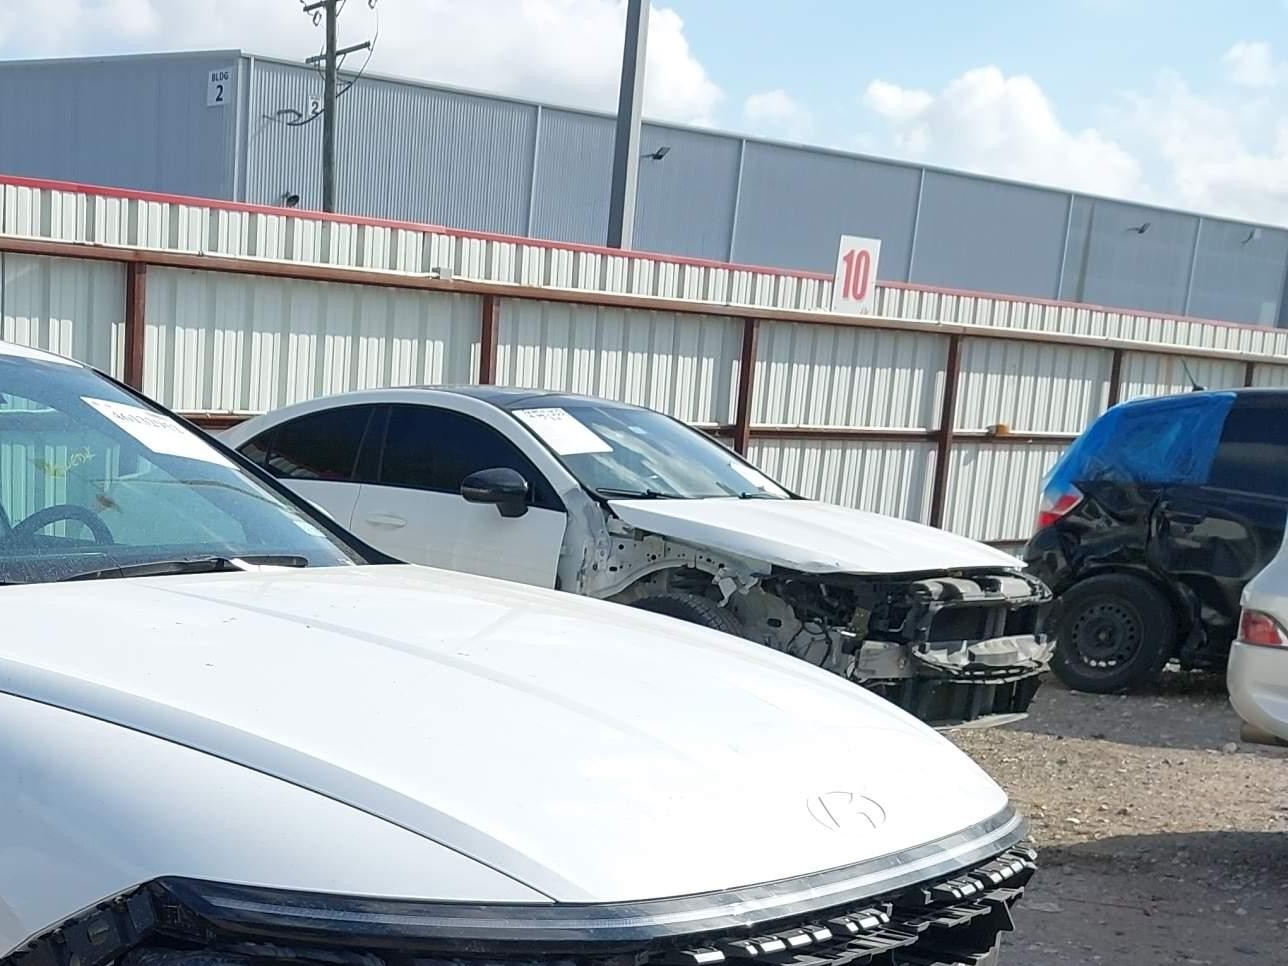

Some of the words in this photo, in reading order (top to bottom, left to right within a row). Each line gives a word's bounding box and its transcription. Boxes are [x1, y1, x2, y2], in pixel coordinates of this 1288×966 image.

[211, 71, 229, 82] BLDG
[215, 84, 224, 102] 2
[311, 101, 319, 115] 2
[842, 249, 870, 300] 10
